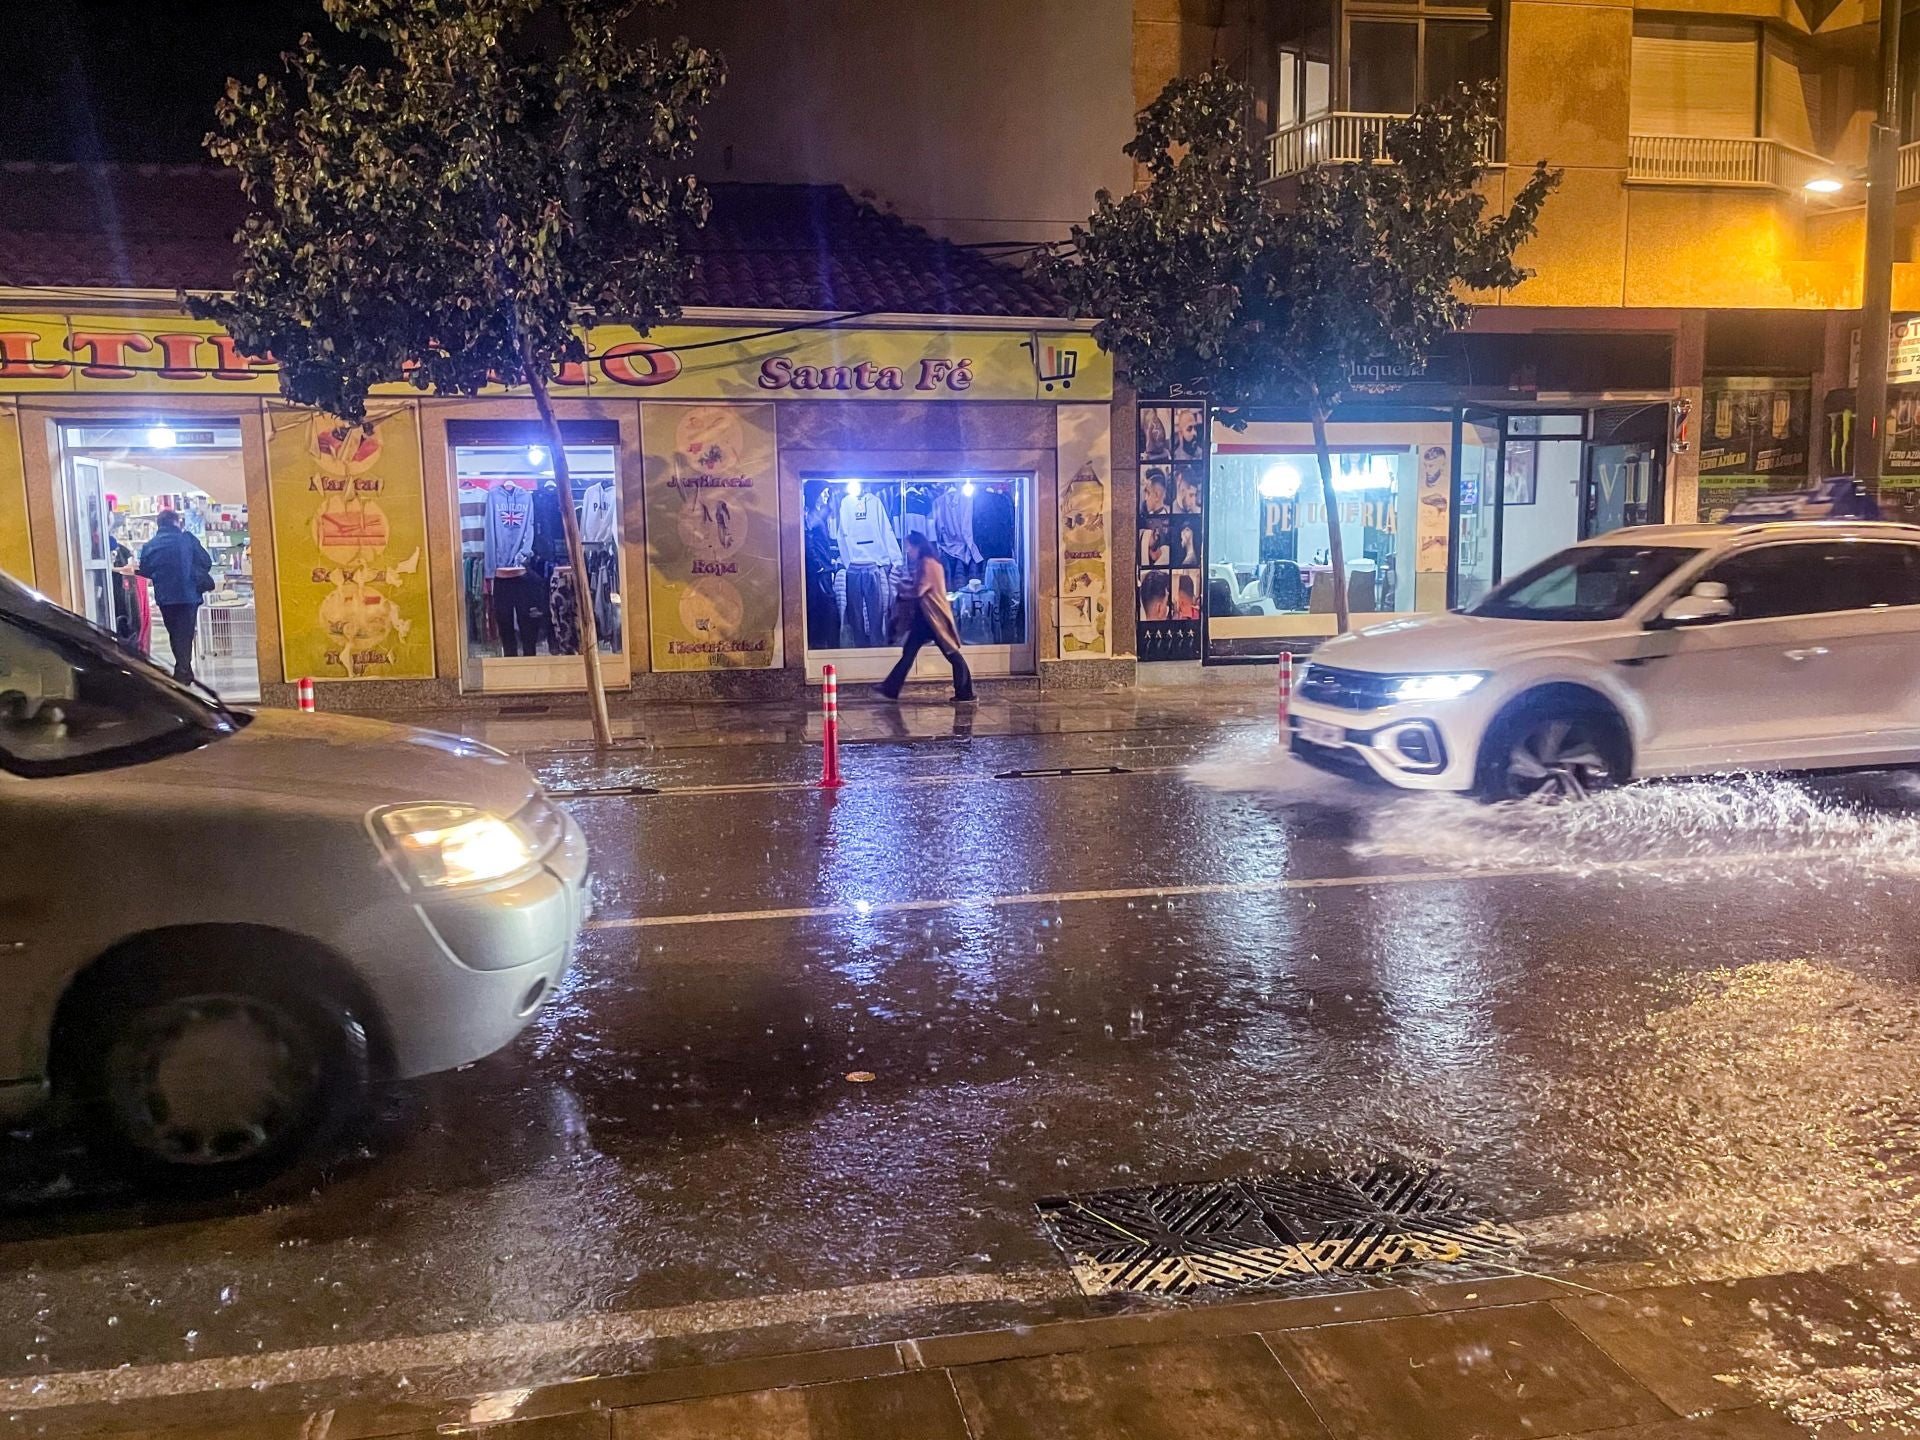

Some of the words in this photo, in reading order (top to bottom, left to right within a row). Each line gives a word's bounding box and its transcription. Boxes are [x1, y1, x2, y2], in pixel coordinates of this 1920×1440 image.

[758, 356, 905, 391] Santa
[915, 357, 973, 391] Fé
[691, 559, 737, 576] Ropa
